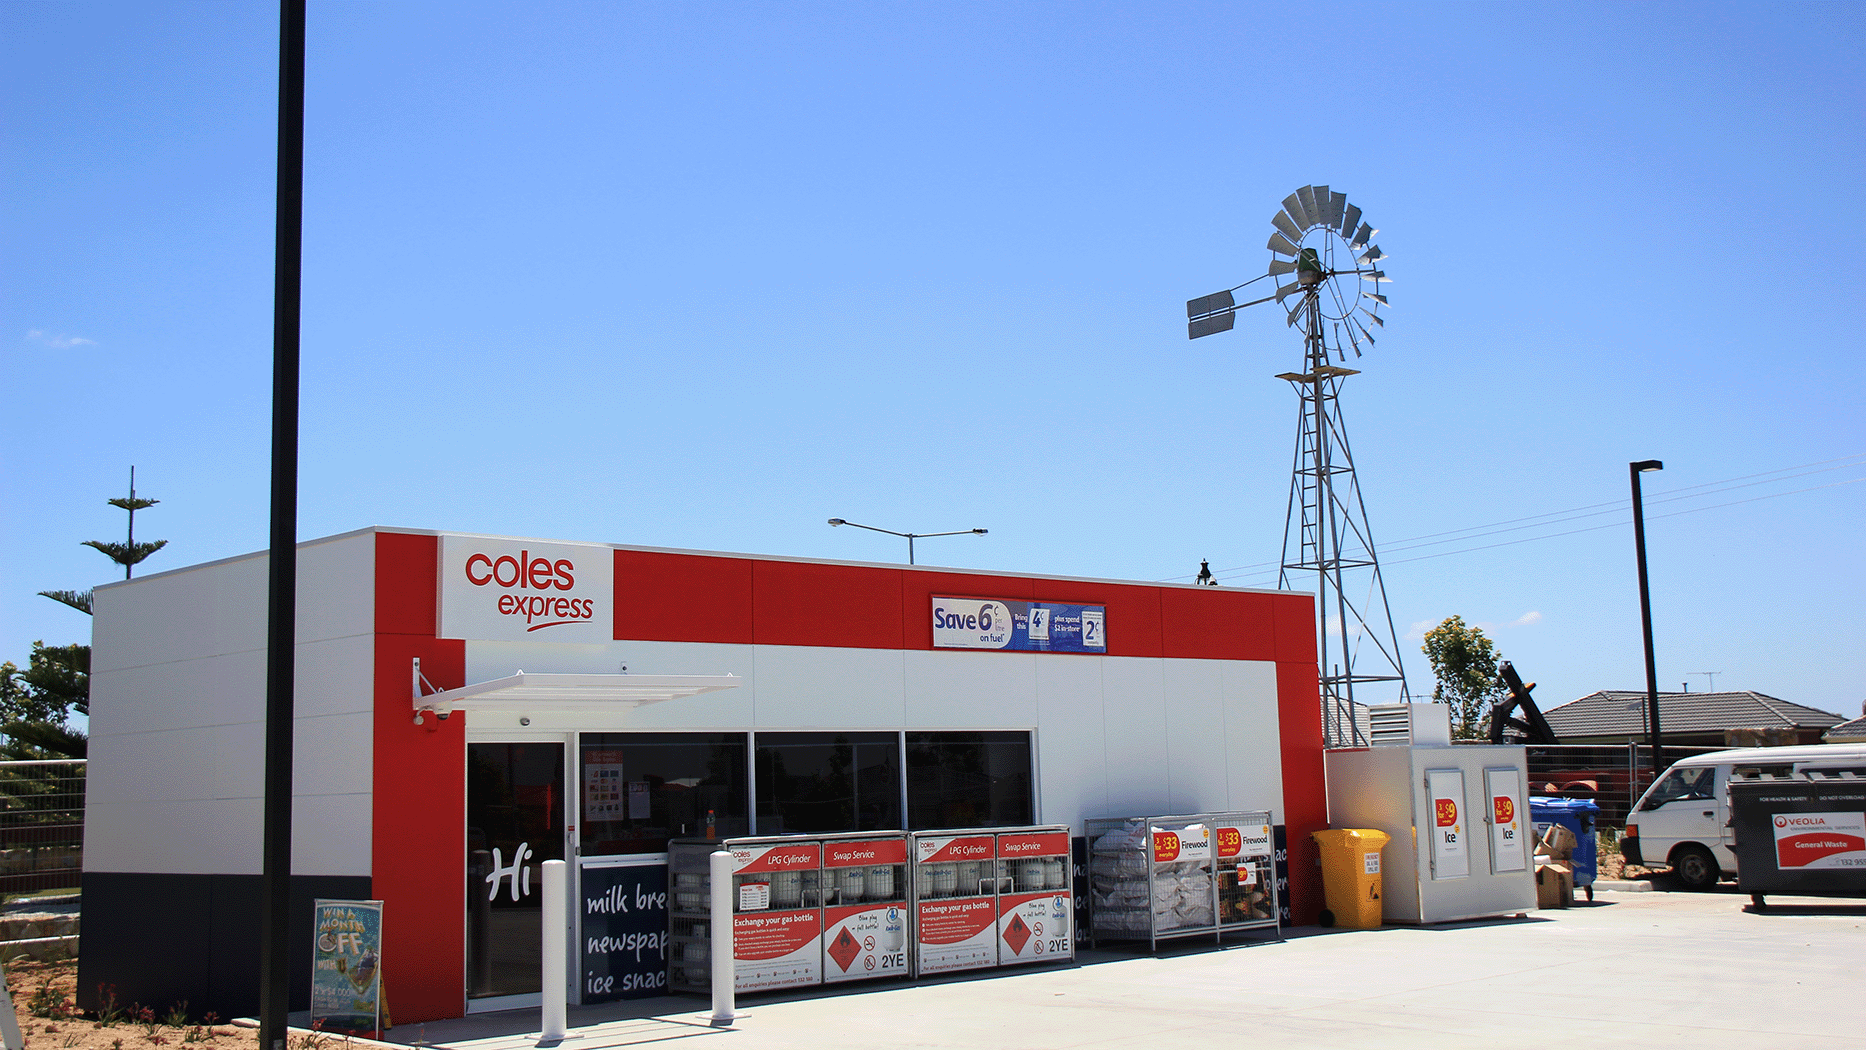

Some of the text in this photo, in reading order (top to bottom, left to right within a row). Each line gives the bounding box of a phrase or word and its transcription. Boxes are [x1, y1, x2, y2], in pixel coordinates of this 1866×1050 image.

[465, 550, 575, 591] coles
[498, 594, 594, 624] express
[934, 607, 976, 630] Save
[1014, 613, 1028, 622] Bring
[1054, 615, 1065, 623] plus
[1065, 616, 1080, 624] spend
[1016, 622, 1027, 630] this
[1054, 624, 1060, 632] $2
[1445, 803, 1455, 818] $9
[1503, 801, 1513, 815] $9
[1226, 832, 1239, 845] $33
[1243, 835, 1268, 845] Firewood
[1445, 831, 1456, 843] Ice
[1502, 828, 1513, 839] Ice
[1005, 842, 1041, 852] Swap Service
[1163, 836, 1177, 850] $33
[1182, 839, 1208, 849] Firewood
[733, 850, 751, 858] coles
[833, 849, 875, 861] Swap Service
[950, 845, 987, 856] LPG Cylinder
[768, 854, 811, 866] LPG Cylinder
[1841, 858, 1853, 866] 132
[485, 842, 533, 902] Hi
[587, 883, 668, 914] milk bre
[323, 907, 356, 920] WIN A
[922, 901, 990, 914] Exchange your gas bottle
[319, 918, 365, 933] MONTH
[734, 913, 813, 927] Exchange your gas bottle
[318, 932, 362, 956] OFF
[1049, 939, 1068, 952] 2YE
[882, 953, 904, 968] 2YE
[588, 970, 667, 994] ice snac
